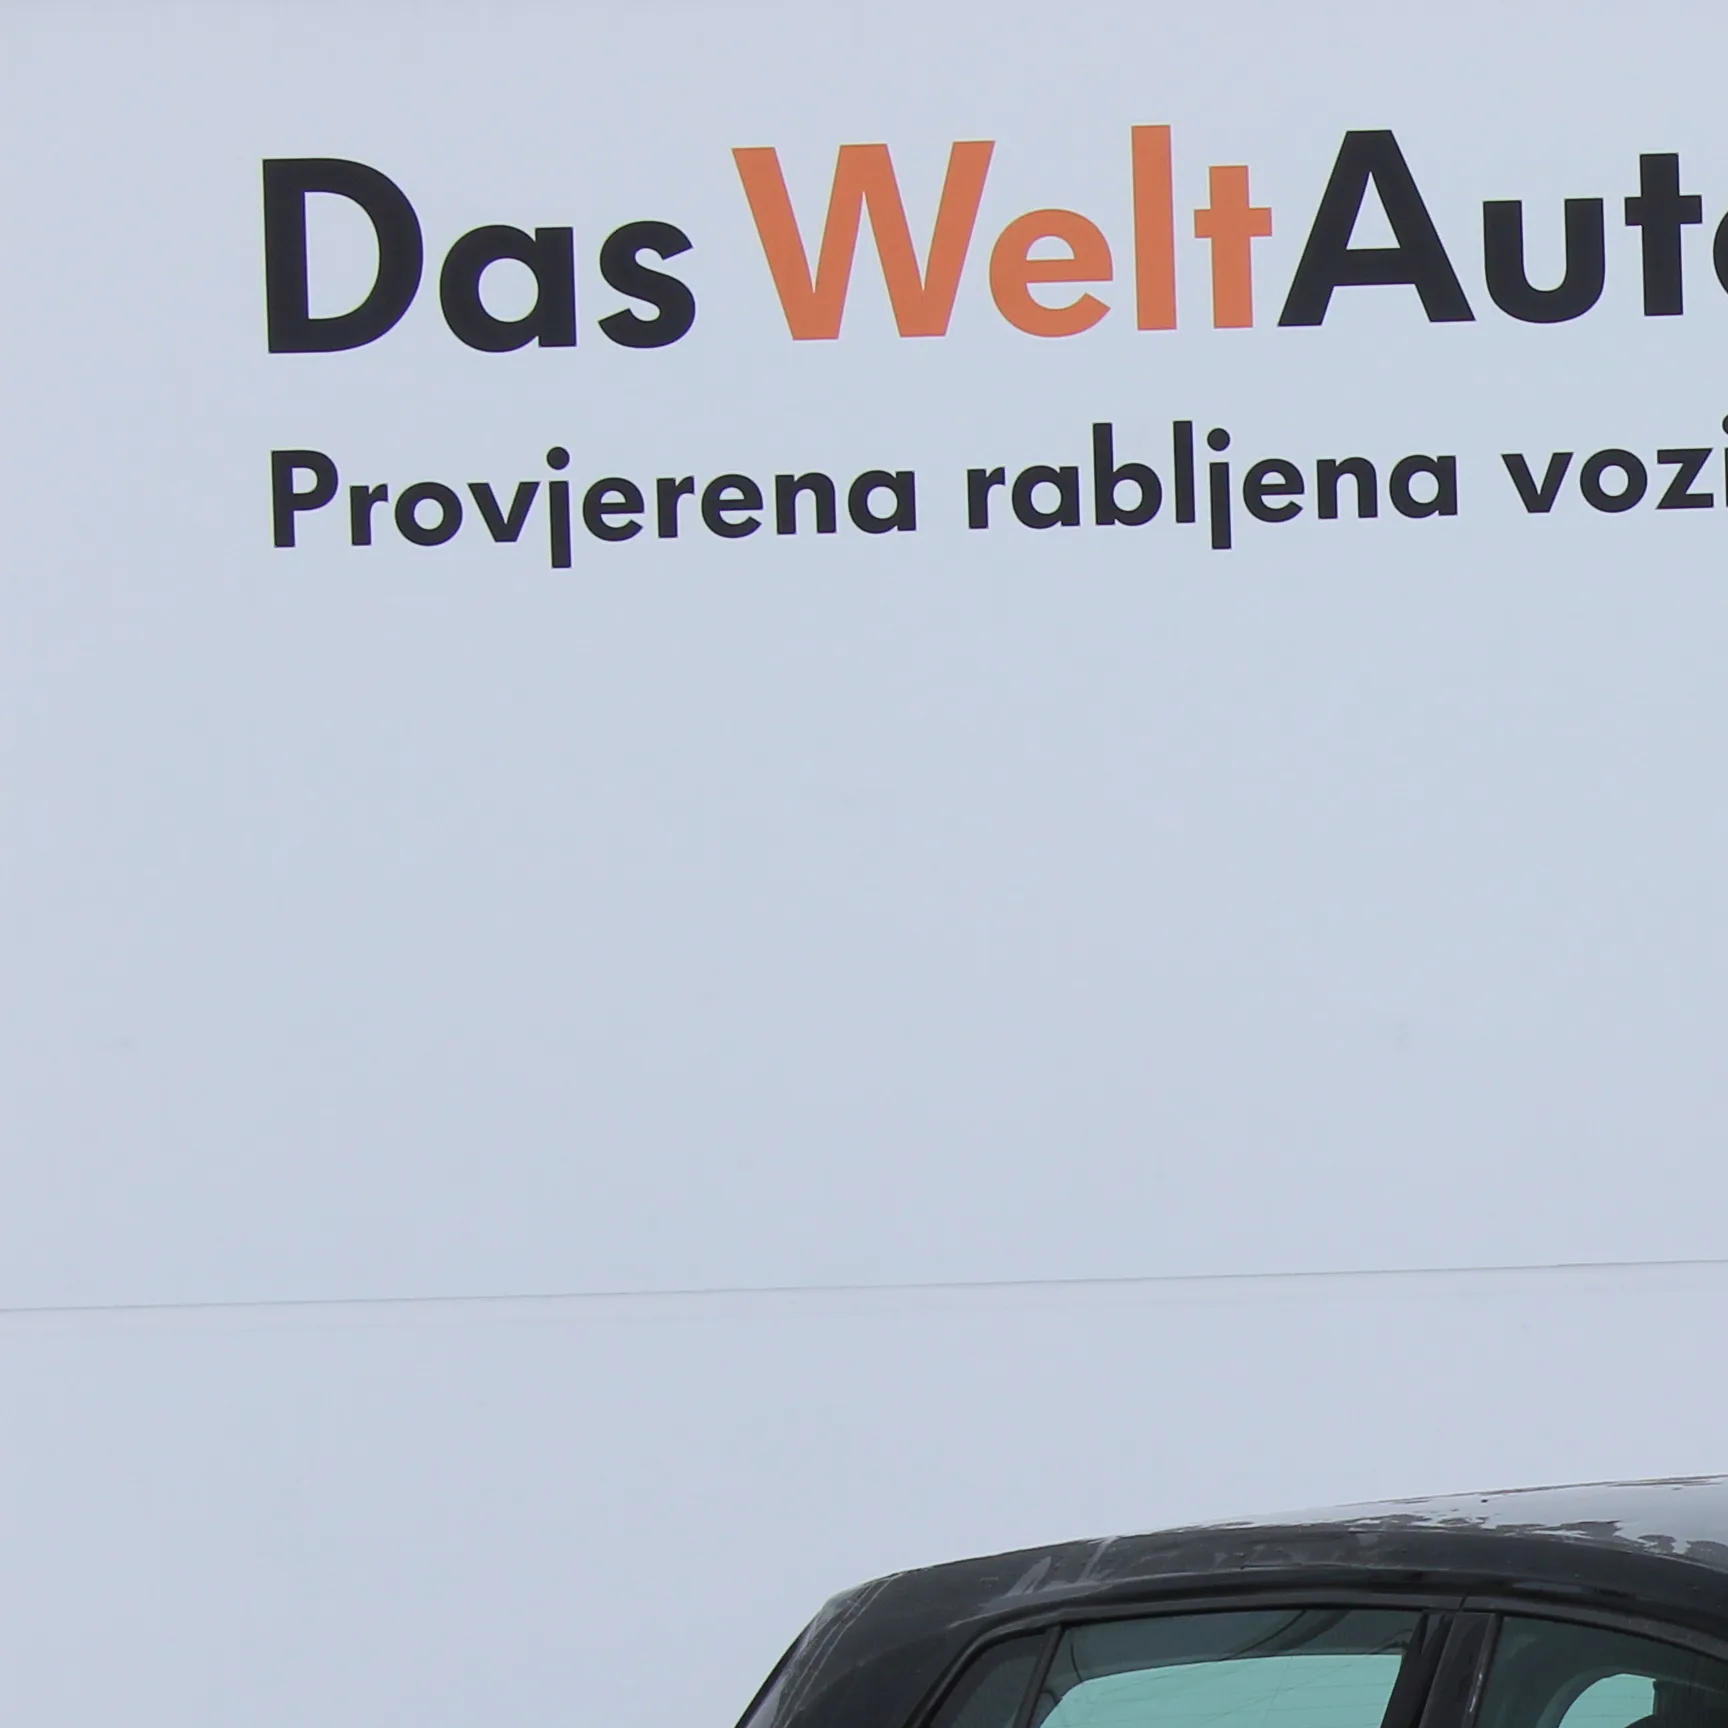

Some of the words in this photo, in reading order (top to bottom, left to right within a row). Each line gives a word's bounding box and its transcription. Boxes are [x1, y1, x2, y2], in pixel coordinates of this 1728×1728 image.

[262, 156, 696, 354] Das
[270, 445, 917, 569] Provjerena
[966, 420, 1458, 550] rabljena
